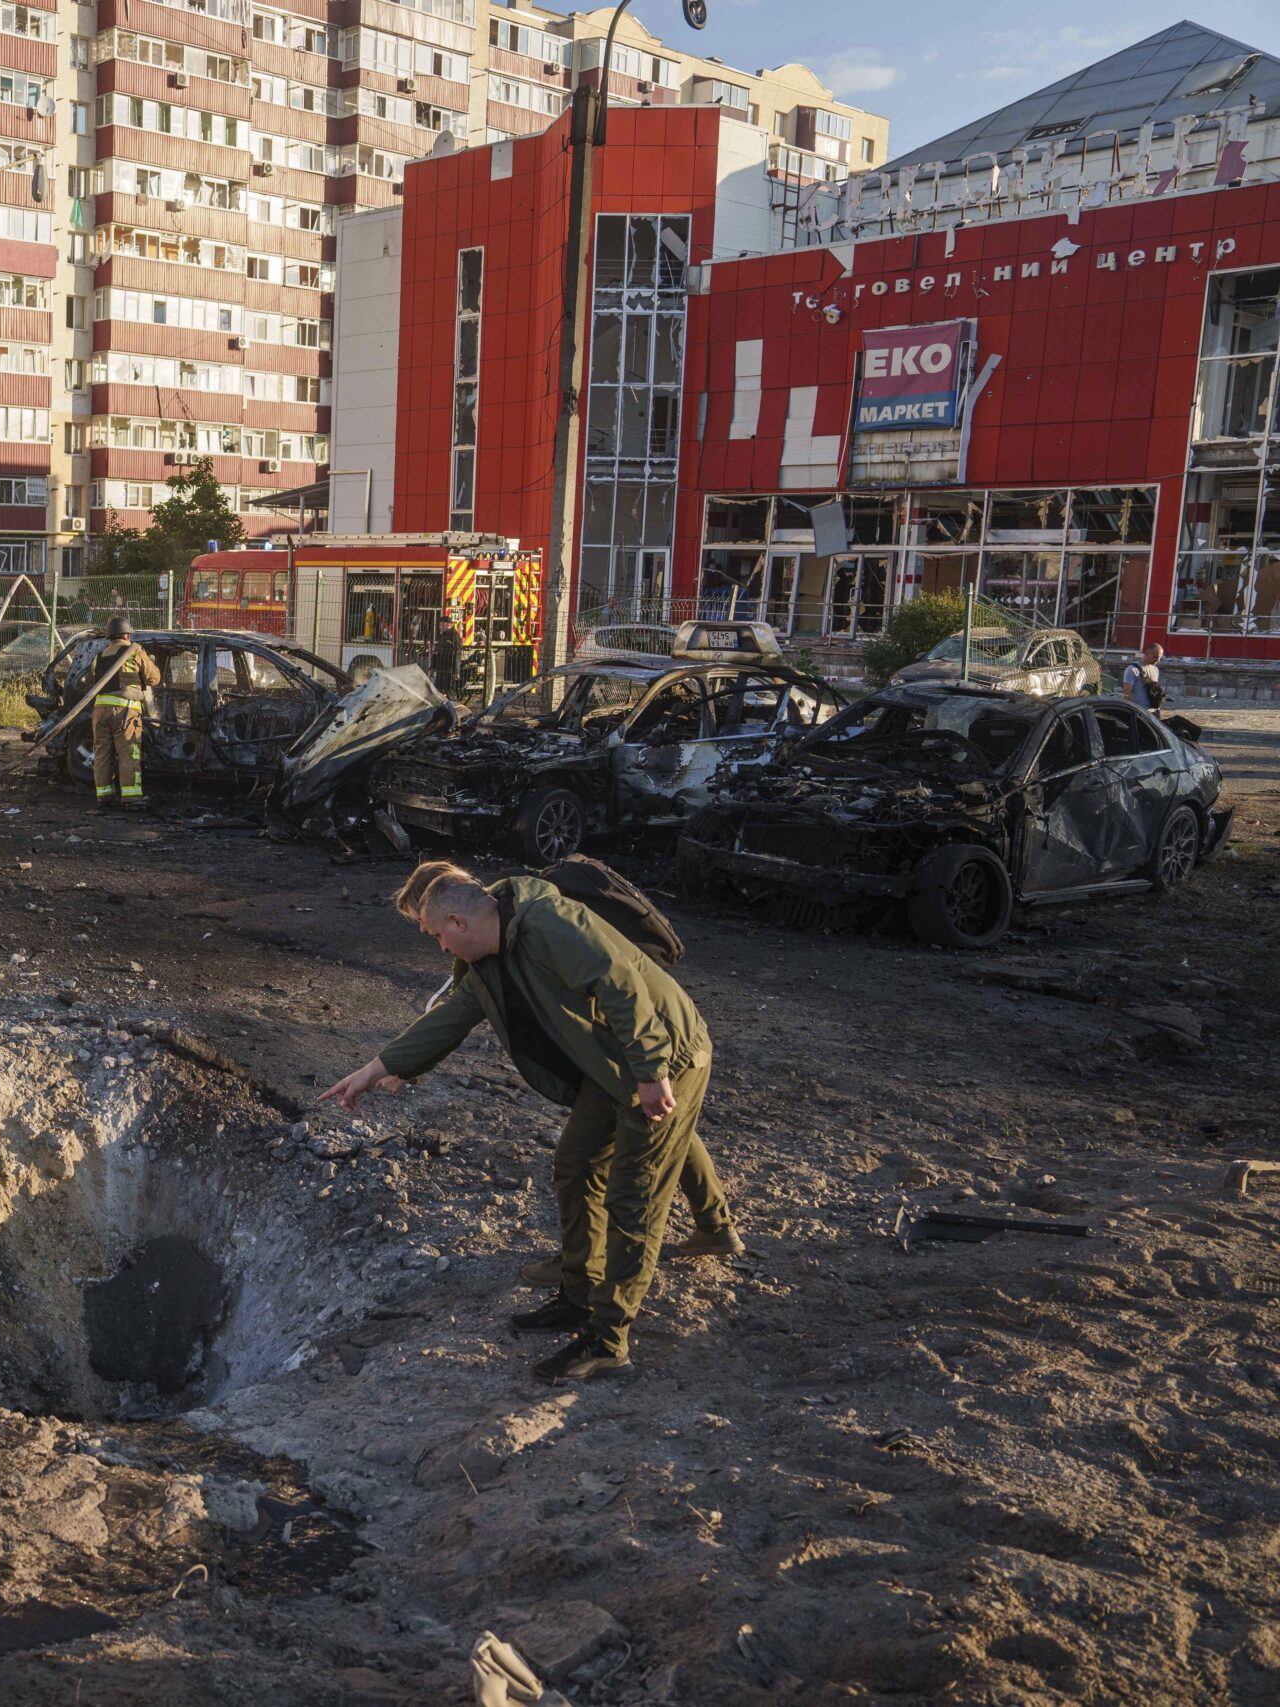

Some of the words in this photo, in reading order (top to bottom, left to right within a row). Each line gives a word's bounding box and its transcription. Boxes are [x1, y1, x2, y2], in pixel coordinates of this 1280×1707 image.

[1096, 237, 1236, 271] центр
[864, 343, 952, 378] ЕКО
[859, 401, 950, 423] МАРКЕТ
[712, 632, 729, 640] 5475
